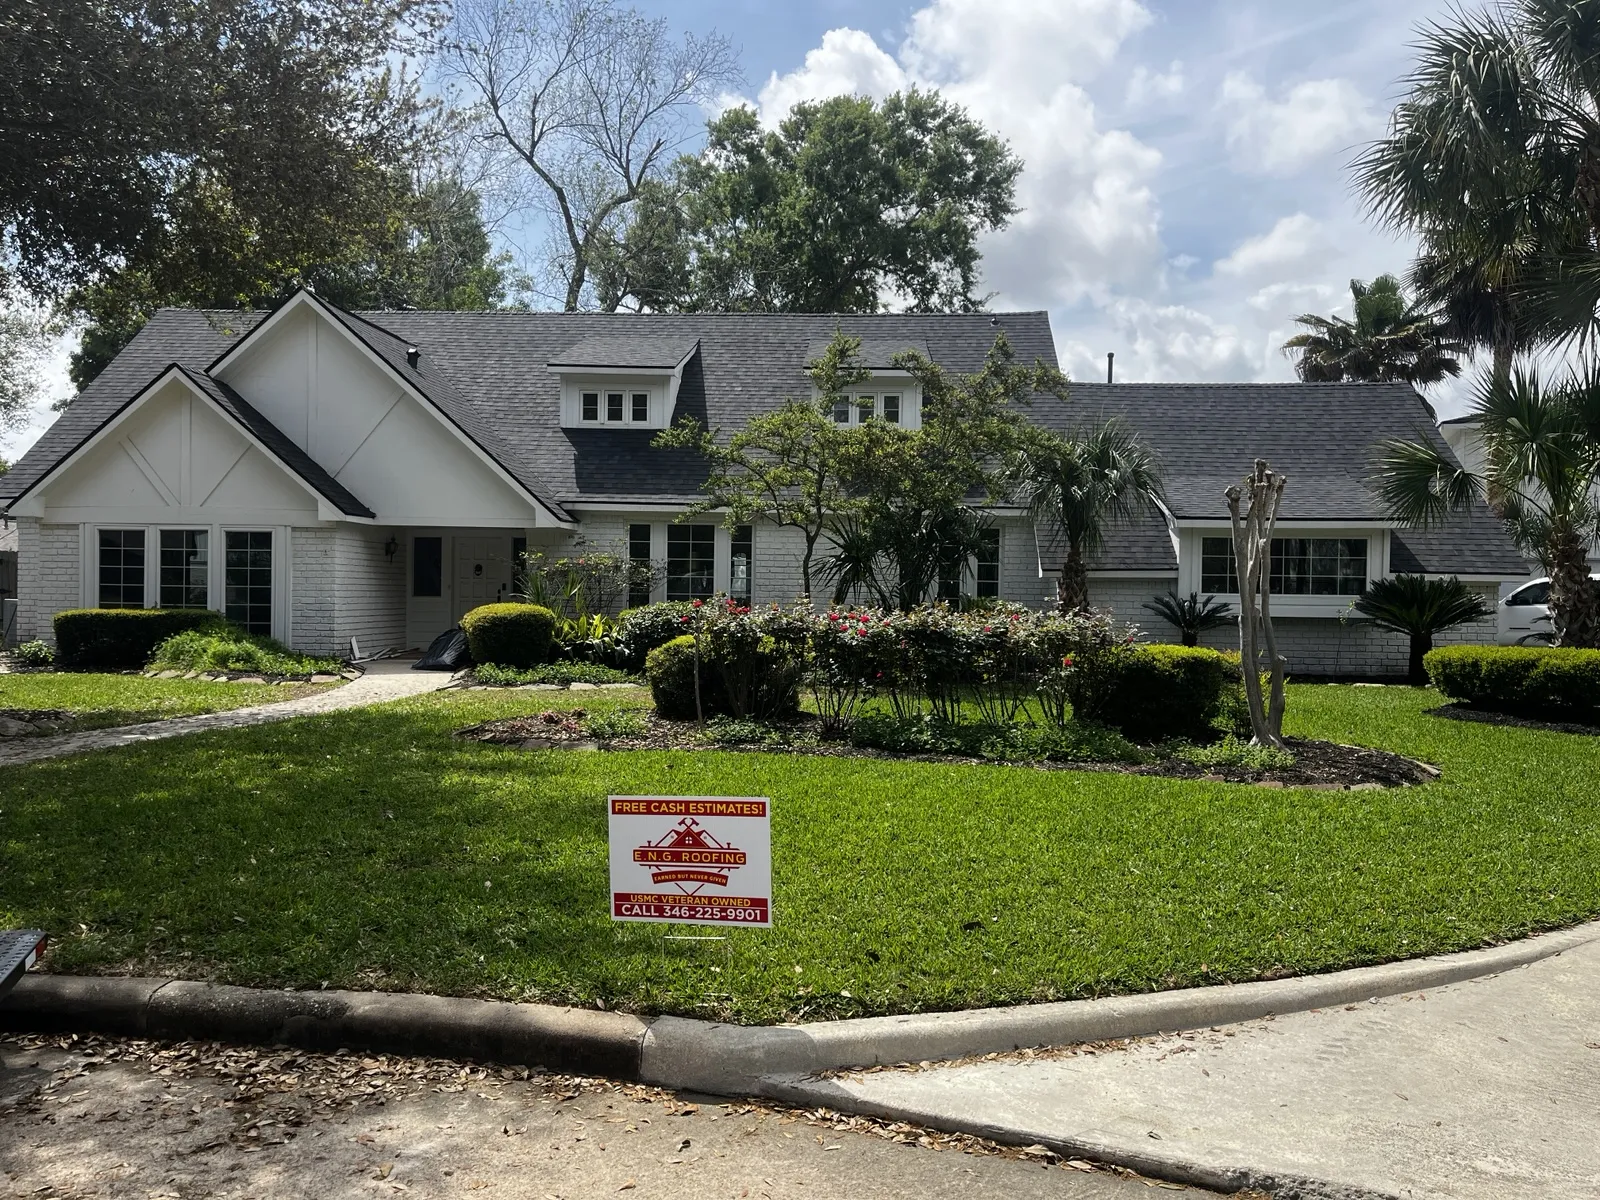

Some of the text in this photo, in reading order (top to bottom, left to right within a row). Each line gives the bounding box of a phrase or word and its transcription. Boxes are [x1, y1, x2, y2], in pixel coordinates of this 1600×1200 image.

[615, 802, 763, 814] FREE CASH ESTIMATES!
[634, 852, 745, 863] E.N.G. ROOFING
[631, 895, 750, 907] USMC VETERAN OWNED
[622, 905, 760, 920] CALL 346-225-9901
